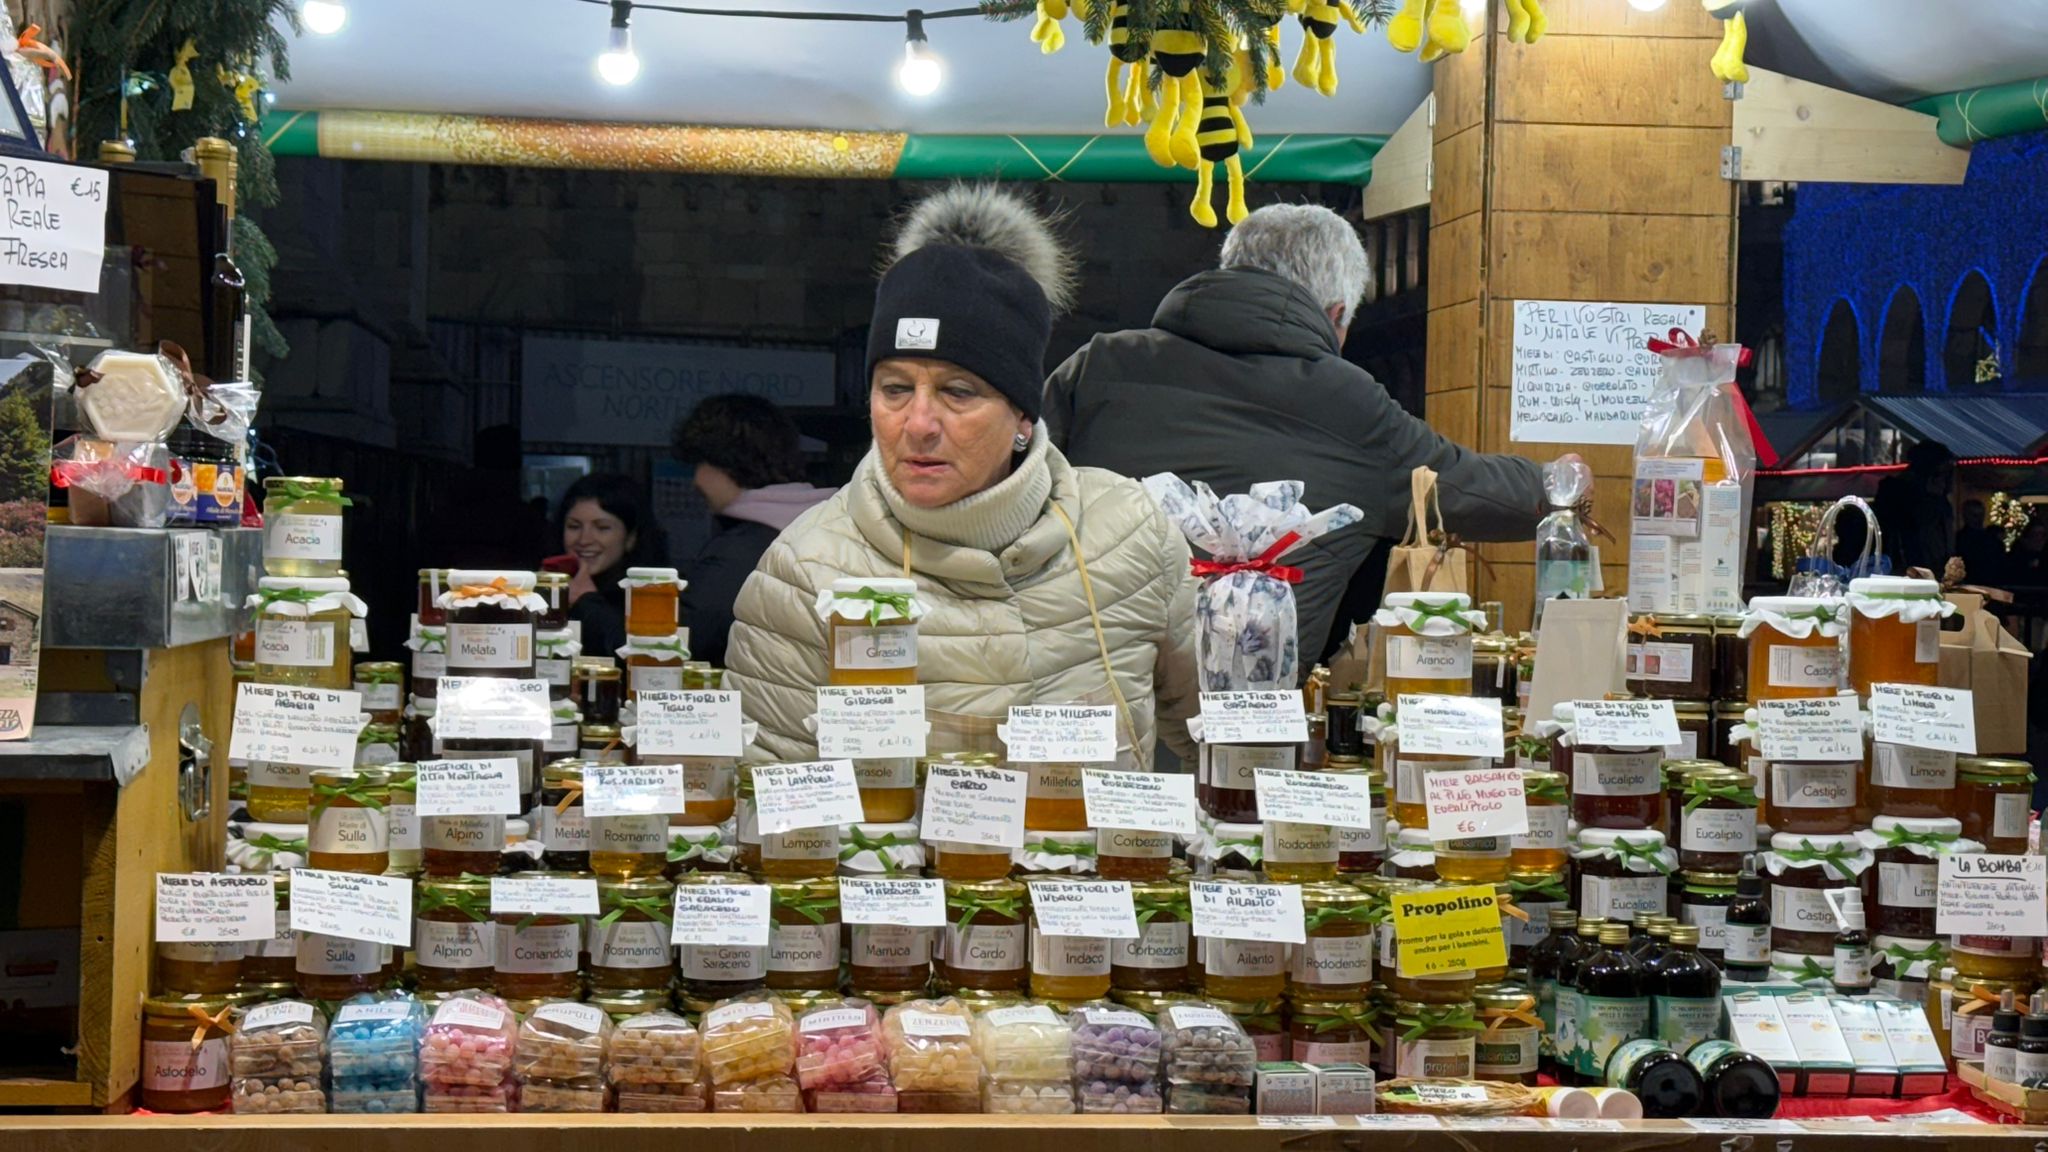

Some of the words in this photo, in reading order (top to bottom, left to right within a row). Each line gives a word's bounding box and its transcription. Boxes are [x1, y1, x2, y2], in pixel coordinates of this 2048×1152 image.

[1523, 302, 1558, 323] PER
[1572, 305, 1631, 323] VOSTRI
[1644, 308, 1687, 326] REGALI
[1524, 324, 1538, 336] DI
[1540, 324, 1598, 342] NATALE
[1605, 325, 1619, 344] VI
[1516, 346, 1541, 360] MIELE
[1564, 350, 1623, 364] CASTIGLIO
[1516, 364, 1557, 377] MIRTILLO
[1570, 366, 1615, 376] ZENZERO
[543, 363, 713, 394] ASCENSORE
[720, 370, 804, 398] NORD
[1517, 379, 1571, 393] LIQUIRIZIA
[1582, 380, 1637, 392] CIOCCOLATO
[1518, 396, 1540, 407] RUM
[285, 533, 321, 545] Acacia
[262, 642, 289, 652] Acacia
[461, 643, 497, 656] Melata
[866, 647, 906, 658] Girasole
[1417, 654, 1455, 666] Arancio
[277, 690, 288, 698] DI
[290, 690, 320, 701] FIORI
[328, 694, 340, 703] DI
[670, 693, 682, 701] DI
[684, 694, 715, 703] FIORI
[719, 694, 730, 702] DI
[819, 688, 848, 696] MIELE
[658, 702, 694, 712] TIGLIO
[844, 697, 894, 706] GIRASOLE
[1619, 702, 1649, 710] FIORI
[1012, 707, 1043, 718] MIELE
[1044, 709, 1059, 718] DI
[266, 764, 301, 775] Acacia
[786, 767, 798, 775] DI
[803, 764, 834, 773] FIORI
[962, 769, 971, 777] DI
[1004, 774, 1015, 782] DI
[1910, 765, 1946, 777] Limone
[769, 778, 782, 786] DI
[1598, 773, 1645, 786] Eucalipto
[1803, 785, 1847, 800] Castiglio
[1456, 820, 1476, 833] €6
[338, 830, 367, 842] Sulla
[445, 827, 484, 842] Alpino
[604, 829, 661, 842] Rosmarino
[1696, 828, 1743, 841] Eucalipto
[782, 837, 832, 850] Lampone
[191, 878, 204, 887] DI
[1076, 884, 1109, 893] FIORI
[1112, 883, 1125, 892] DI
[1228, 887, 1242, 895] DI
[1246, 886, 1283, 897] FIORI
[679, 895, 696, 904] DI
[1203, 895, 1217, 904] DI
[1226, 896, 1275, 907] AILANTO
[1612, 898, 1658, 911] Eucalipto
[1401, 896, 1493, 917] Propolino
[326, 949, 355, 962] Sulla
[433, 943, 473, 958] Alpino
[514, 947, 574, 959] Coriandolo
[603, 944, 662, 957] Rosmarino
[718, 949, 751, 959] Grano
[771, 948, 822, 960] Lampone
[866, 944, 911, 957] Marruca
[970, 946, 1006, 959] Cardo
[1127, 943, 1186, 956] Corbezzolo
[703, 959, 751, 969] Saraceno
[1066, 952, 1104, 964] Indaco
[1237, 952, 1274, 965] Ailanto
[1305, 956, 1367, 970] Rododendro
[155, 1065, 207, 1078] Asfodelo
